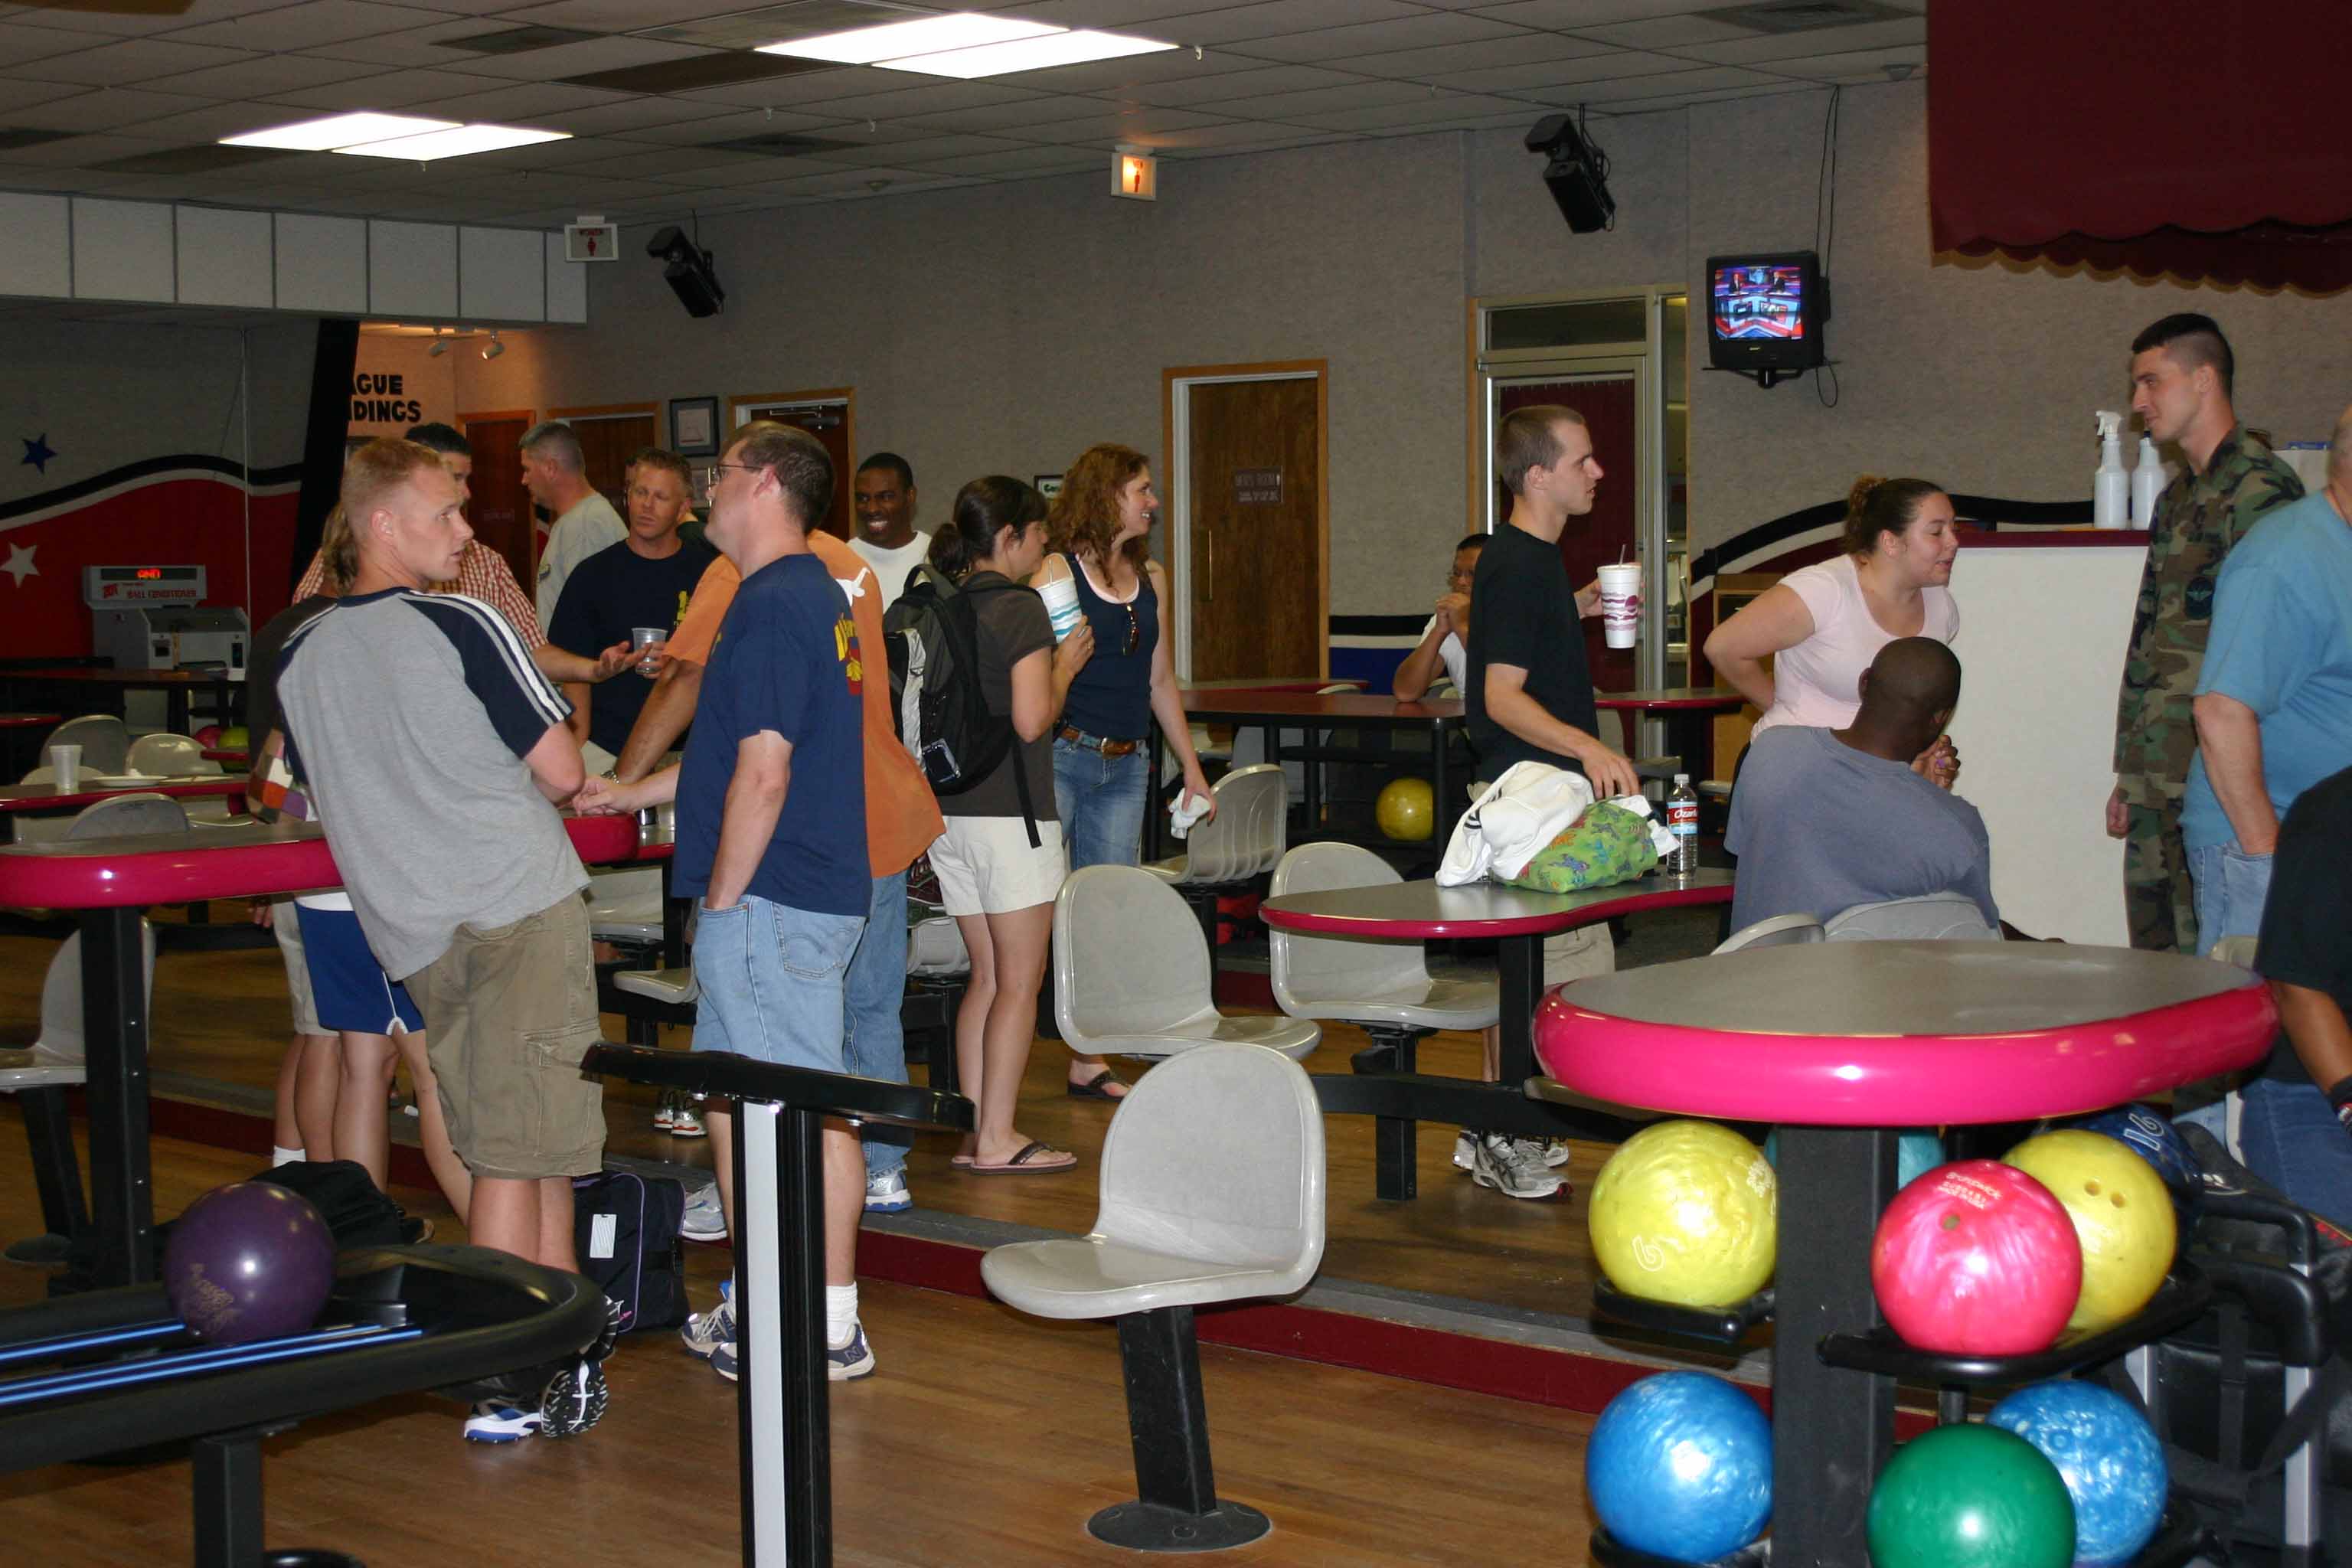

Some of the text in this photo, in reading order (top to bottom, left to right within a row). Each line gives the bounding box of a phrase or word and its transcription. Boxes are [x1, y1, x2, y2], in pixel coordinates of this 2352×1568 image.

[352, 374, 403, 395] GUE
[349, 400, 421, 422] DINGS
[2123, 1112, 2165, 1152] 16
[844, 1345, 863, 1363] N
